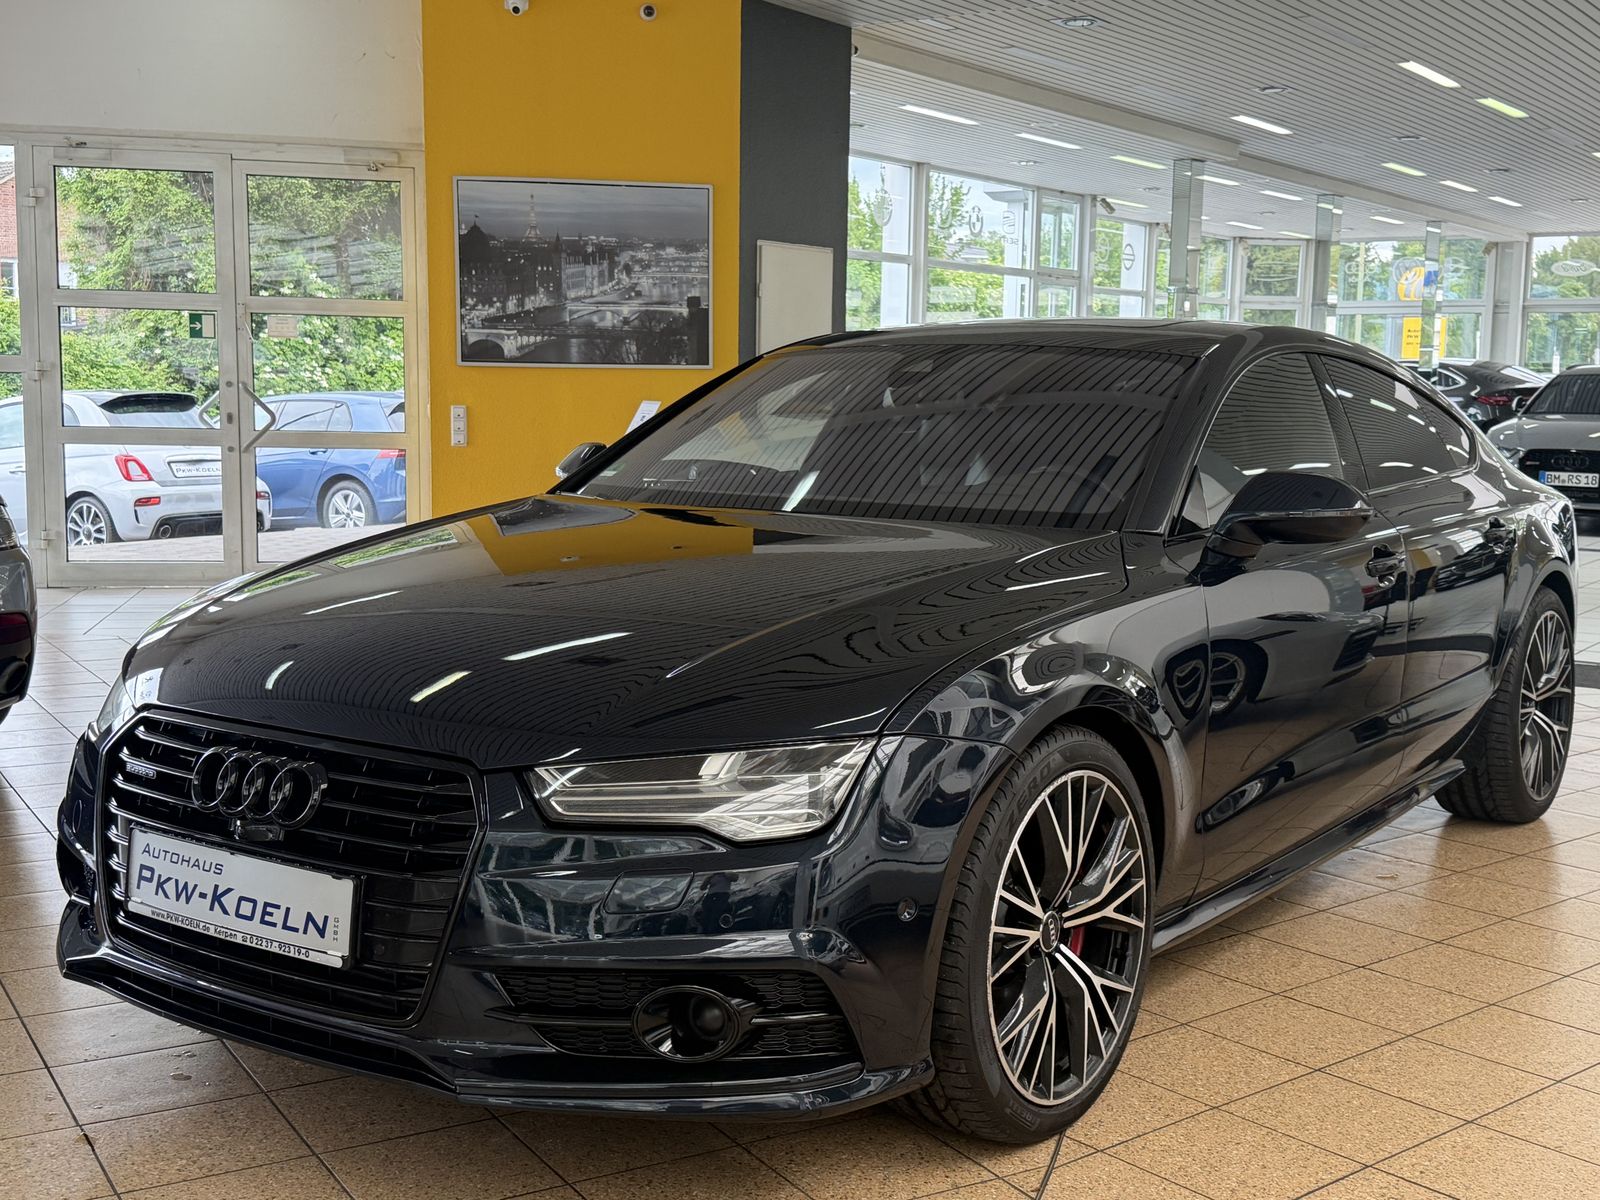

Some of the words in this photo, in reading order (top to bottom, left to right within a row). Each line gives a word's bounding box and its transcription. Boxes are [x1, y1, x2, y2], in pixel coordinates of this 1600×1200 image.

[1546, 474, 1561, 484] BM
[1567, 474, 1582, 485] RS
[1584, 475, 1598, 486] 18
[141, 842, 224, 875] AUTOHAUS
[136, 863, 329, 939] PKW-KOELN
[151, 909, 210, 933] www.PKW-KOELN.de
[214, 926, 238, 941] Kerpen
